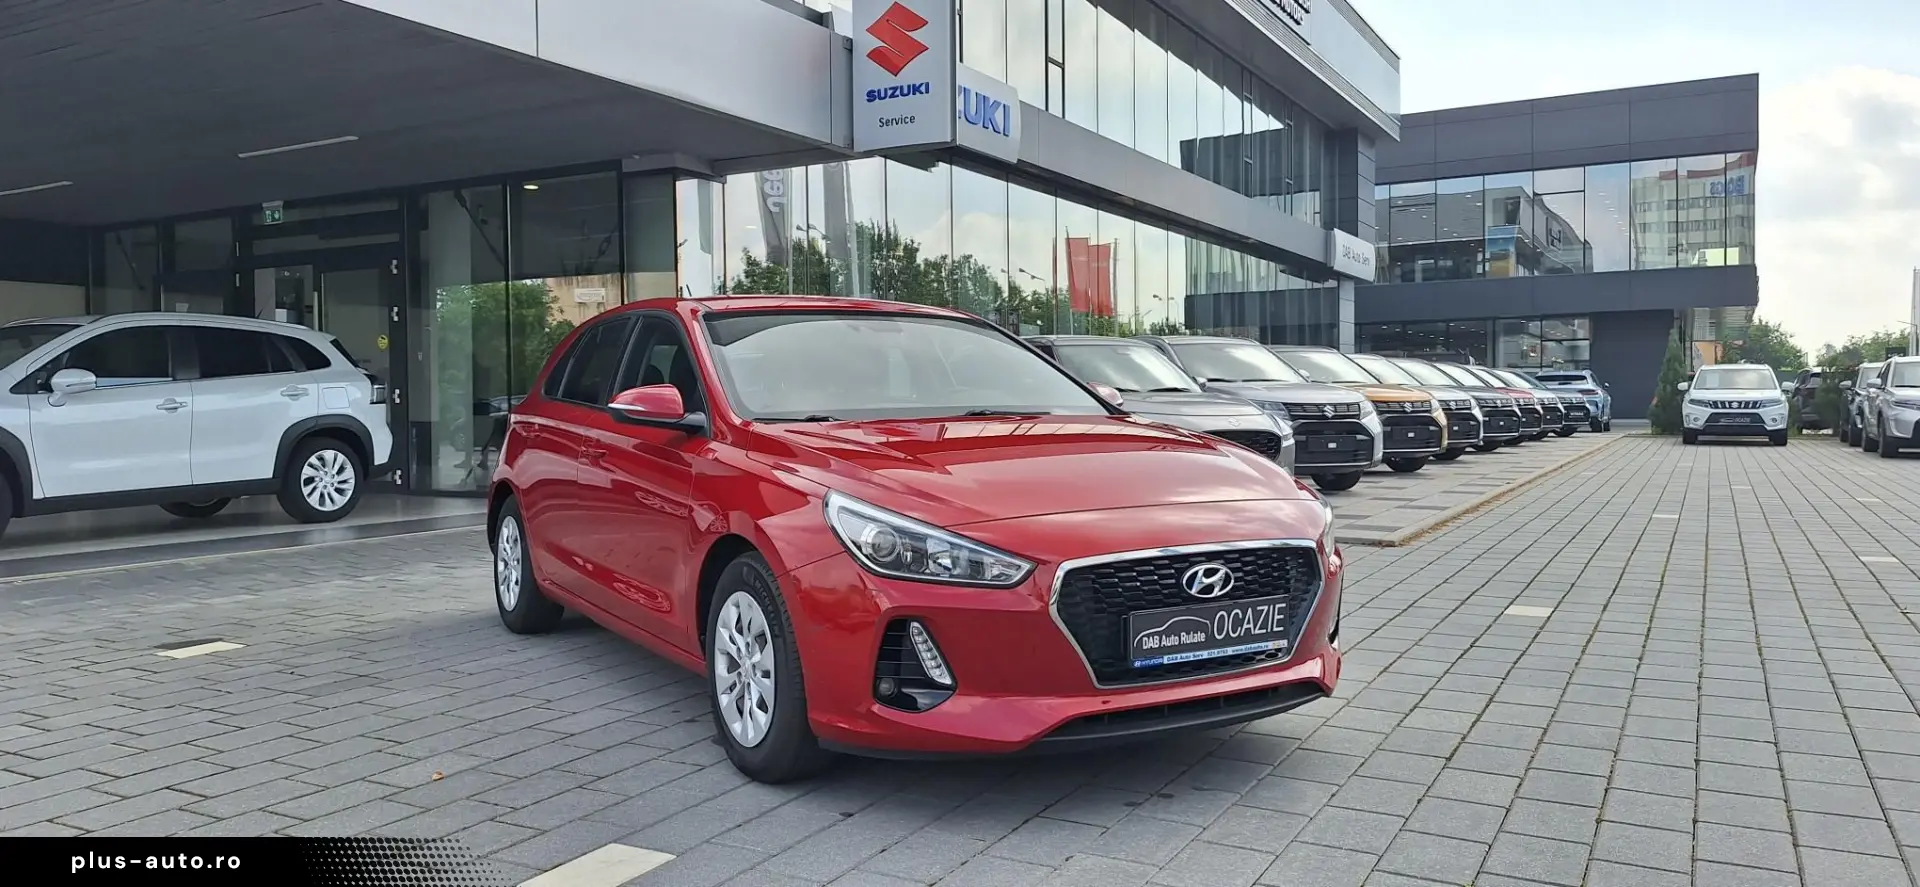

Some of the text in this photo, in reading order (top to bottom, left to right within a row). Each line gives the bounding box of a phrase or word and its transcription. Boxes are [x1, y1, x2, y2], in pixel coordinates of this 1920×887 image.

[866, 82, 930, 102] SUZUKI
[958, 85, 1010, 137] UKI
[878, 115, 916, 128] Service
[1214, 603, 1286, 640] OCAZIE
[1142, 631, 1206, 650] DAB Auto Rulate
